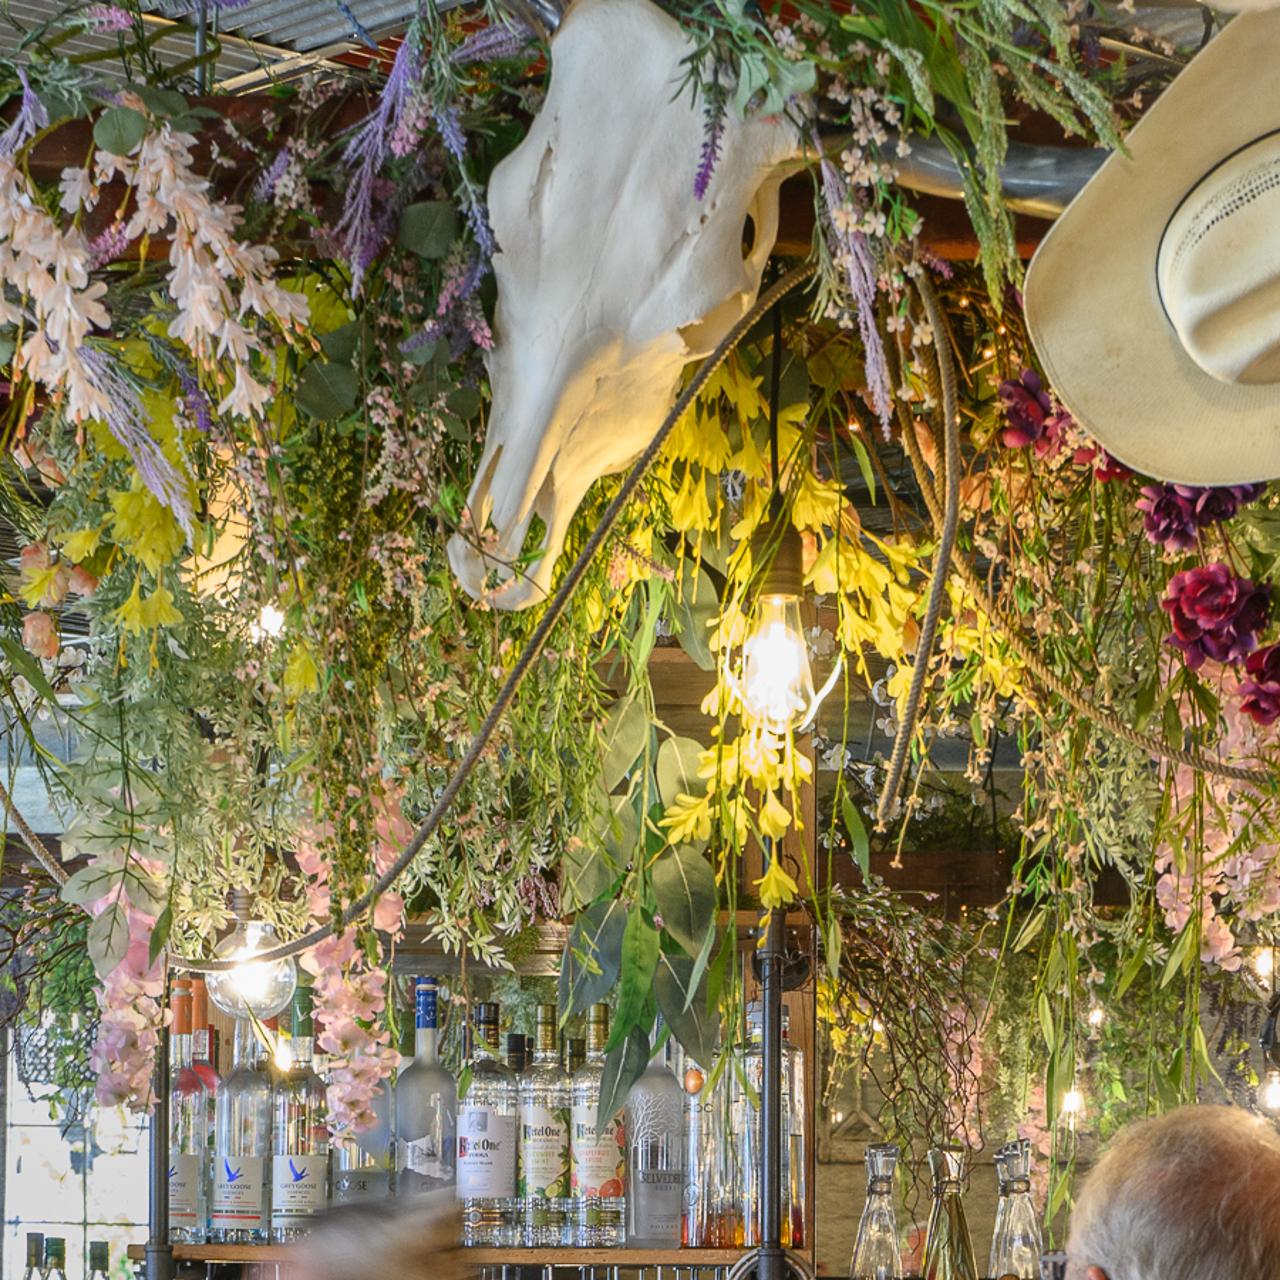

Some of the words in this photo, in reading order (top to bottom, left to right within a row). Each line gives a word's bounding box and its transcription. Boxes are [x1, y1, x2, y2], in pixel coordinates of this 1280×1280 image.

[523, 1124, 544, 1140] Ketel
[545, 1126, 561, 1137] One
[482, 1138, 502, 1151] One
